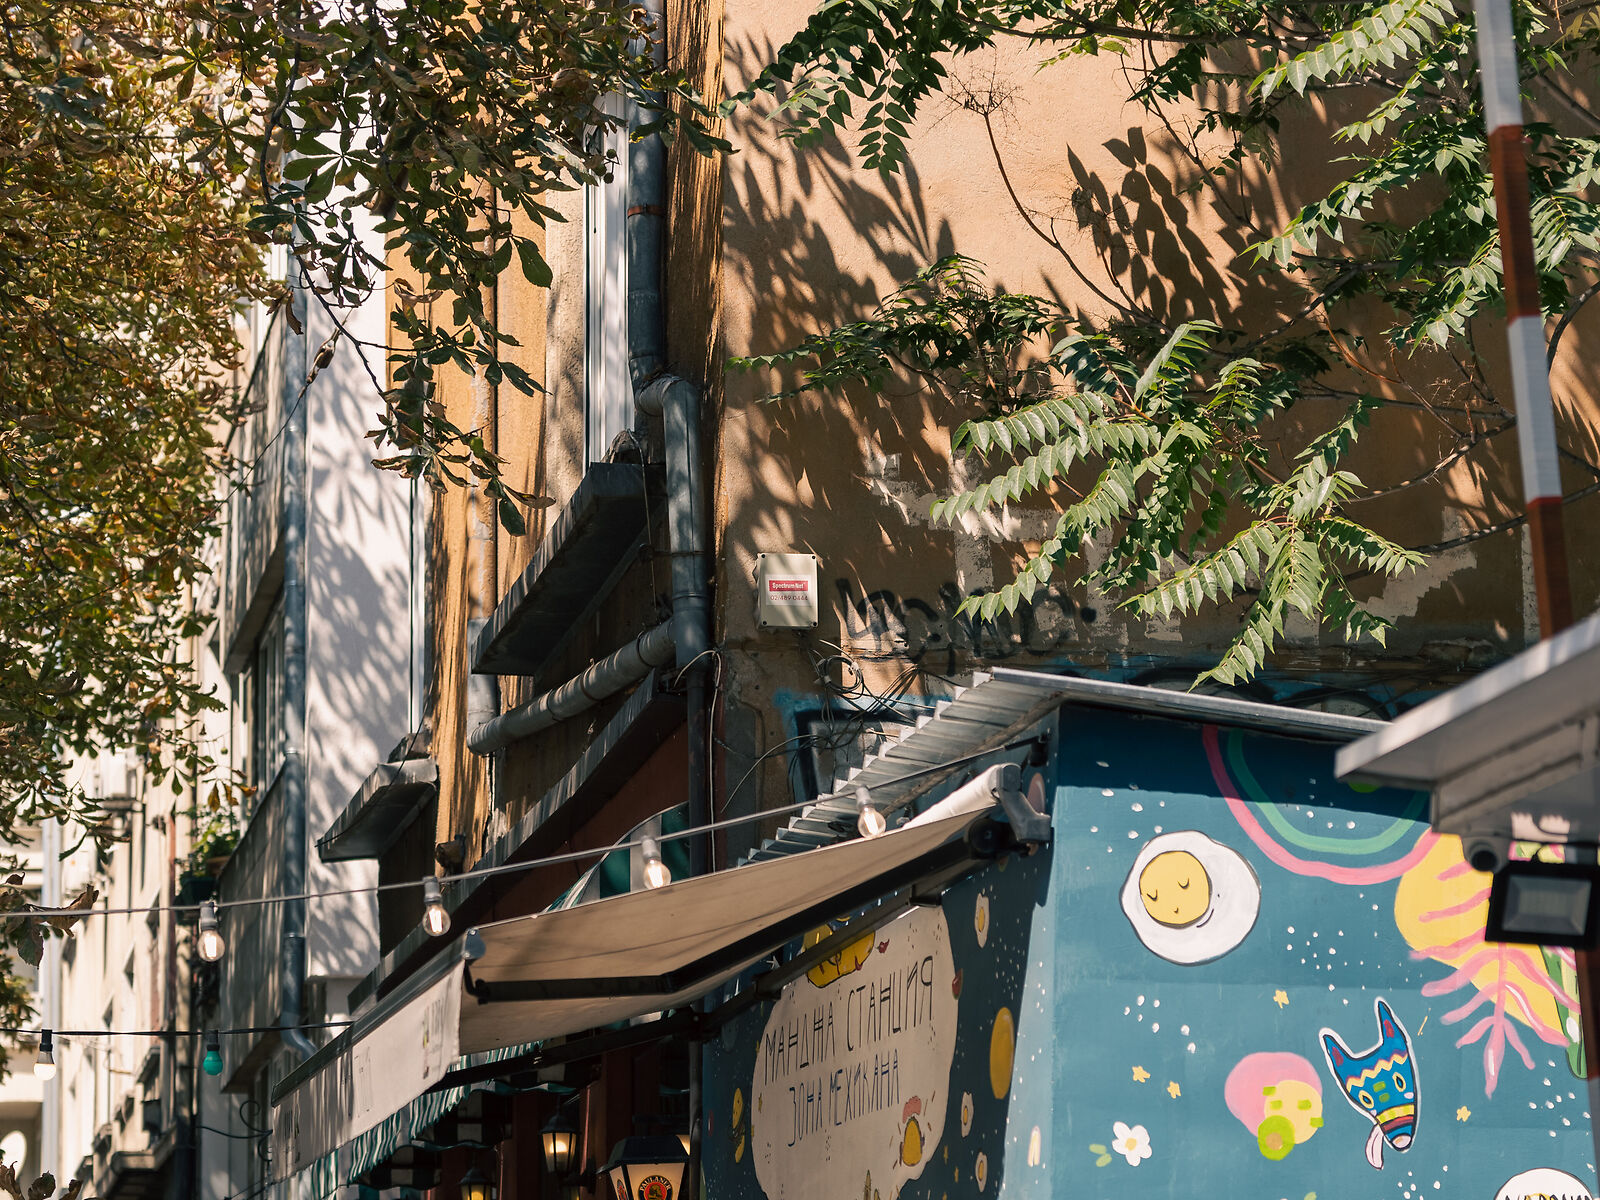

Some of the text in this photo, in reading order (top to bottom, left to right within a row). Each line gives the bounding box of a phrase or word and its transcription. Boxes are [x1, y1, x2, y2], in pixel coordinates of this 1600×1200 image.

[764, 955, 934, 1086] МАНДЖА СТАНЦИЯ
[787, 1048, 900, 1147] ЗОНА МЕХИКАНА
